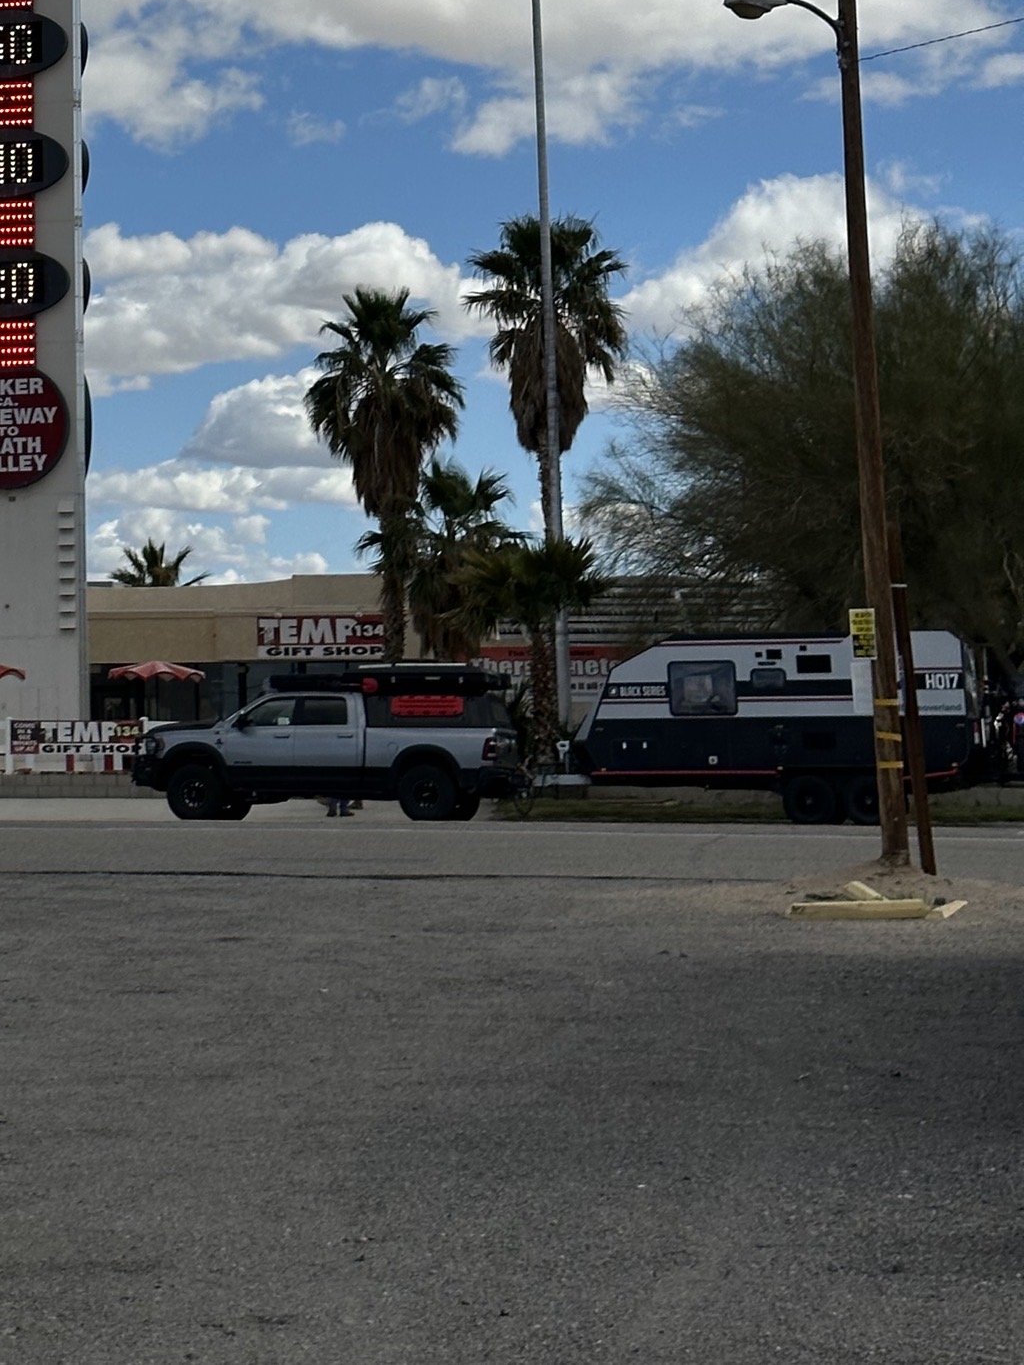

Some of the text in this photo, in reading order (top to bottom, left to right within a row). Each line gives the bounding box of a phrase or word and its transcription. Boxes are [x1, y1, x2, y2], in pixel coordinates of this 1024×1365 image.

[259, 618, 384, 644] TEMP 134
[266, 646, 383, 656] GIFT SHOP
[40, 721, 140, 743] TEMP 134
[42, 744, 142, 753] GIFT SHOP
